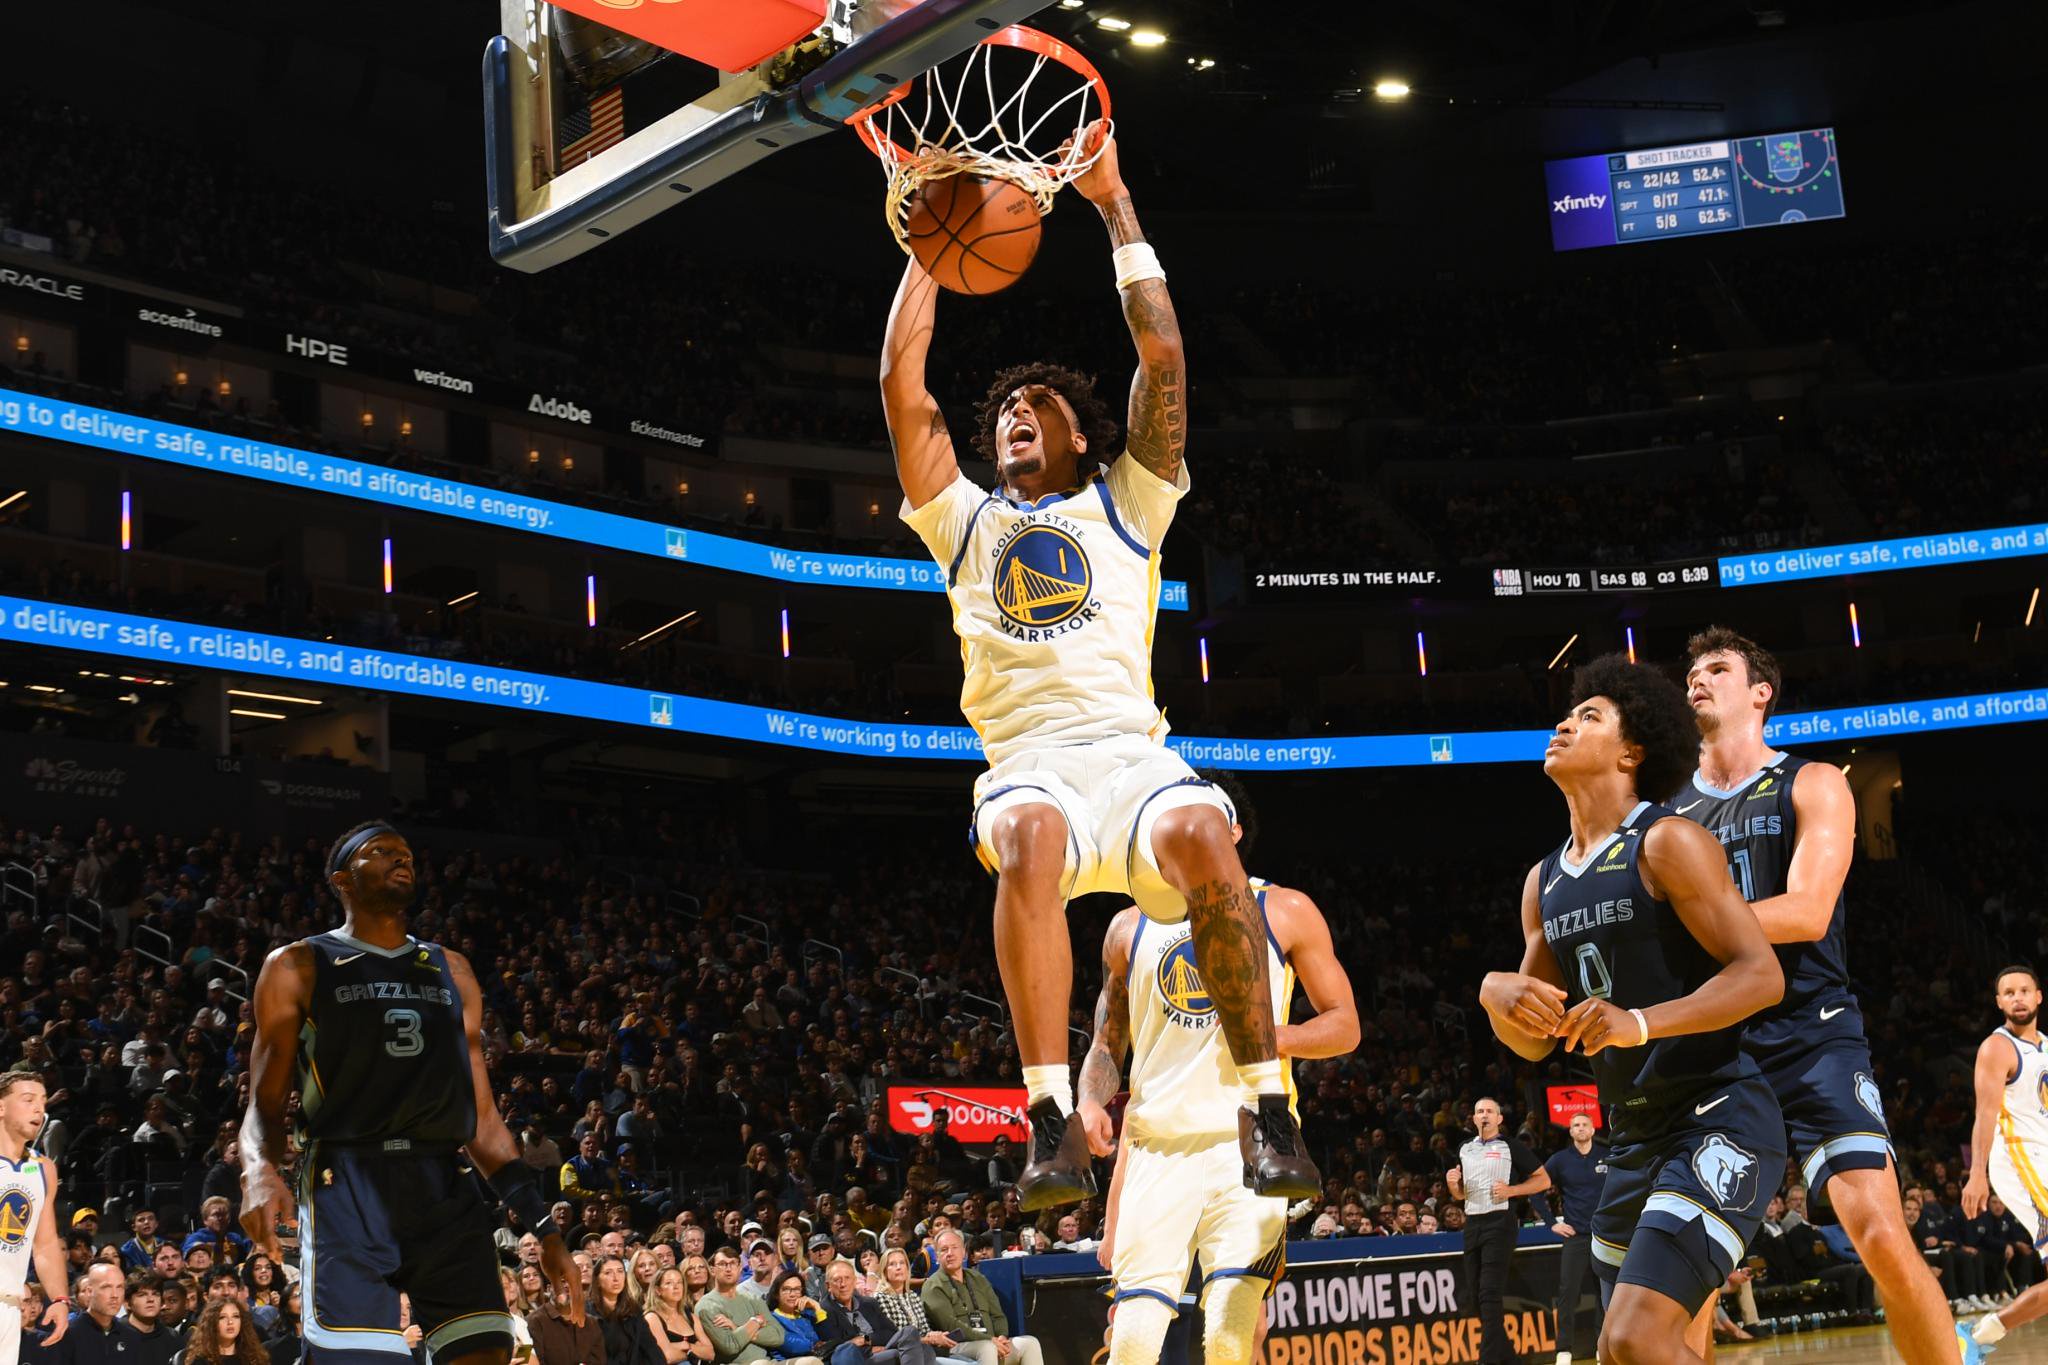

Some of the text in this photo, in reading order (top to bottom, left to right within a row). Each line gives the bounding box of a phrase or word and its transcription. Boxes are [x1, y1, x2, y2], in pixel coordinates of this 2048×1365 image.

[1638, 147, 1713, 166] SHOT TRACKER
[1617, 181, 1631, 190] FG
[1643, 171, 1680, 188] 22/42
[1553, 194, 1607, 213] xfinity
[1653, 192, 1679, 208] 8/17
[1622, 223, 1635, 232] FT
[1656, 214, 1678, 230] 5/8
[139, 309, 223, 337] accenture
[286, 334, 348, 366] HPE
[414, 368, 473, 393] verizon
[528, 394, 592, 424] Adobe
[630, 420, 705, 449] ticketmaster
[28, 404, 54, 426] to
[61, 411, 149, 444] deliver
[155, 429, 215, 462] safe,
[220, 444, 316, 482] reliable,
[322, 462, 362, 487] and
[368, 471, 475, 510] affordable
[481, 497, 554, 529] energy.
[992, 513, 1086, 558] GOLDEN STATE
[1058, 547, 1067, 574] 1
[1751, 560, 1770, 576] to
[1775, 551, 1843, 573] deliver
[1849, 545, 1898, 567] safe,
[1903, 537, 1986, 561] reliable,
[1991, 529, 2028, 550] and
[769, 551, 823, 576] We're
[828, 560, 906, 586] working
[911, 566, 930, 583] to
[1256, 571, 1442, 587] 2 MINUTES IN THE HALF.
[1502, 569, 1521, 585] NBA
[1533, 573, 1580, 588] HOU 70
[1600, 567, 1709, 586] SAS 68 Q3 6:39
[1494, 586, 1523, 596] SCORES
[1000, 598, 1102, 643] WARRIORS
[14, 606, 110, 640] deliver
[118, 624, 181, 655] safe,
[190, 634, 293, 669] reliable,
[300, 651, 343, 674] and
[350, 655, 466, 690] affordable
[472, 675, 550, 705] energy.
[1790, 716, 1838, 737] safe,
[1843, 704, 1926, 730] reliable,
[1932, 701, 1969, 721] and
[1975, 692, 2048, 717] afforda
[766, 714, 817, 739] We're
[822, 726, 896, 752] working
[901, 731, 921, 748] to
[215, 758, 241, 773] 104
[1170, 741, 1336, 766] affordable energy.
[287, 783, 360, 800] DOORDASH
[1596, 862, 1627, 873] Robinhood
[1728, 848, 1755, 901] 1
[1575, 942, 1612, 999] 0
[335, 982, 453, 1006] GRIZZLIES
[1162, 1002, 1218, 1029] WARRI
[384, 1008, 425, 1057] 3
[1304, 1272, 1395, 1327] HOME
[1398, 1268, 1458, 1317] FOR
